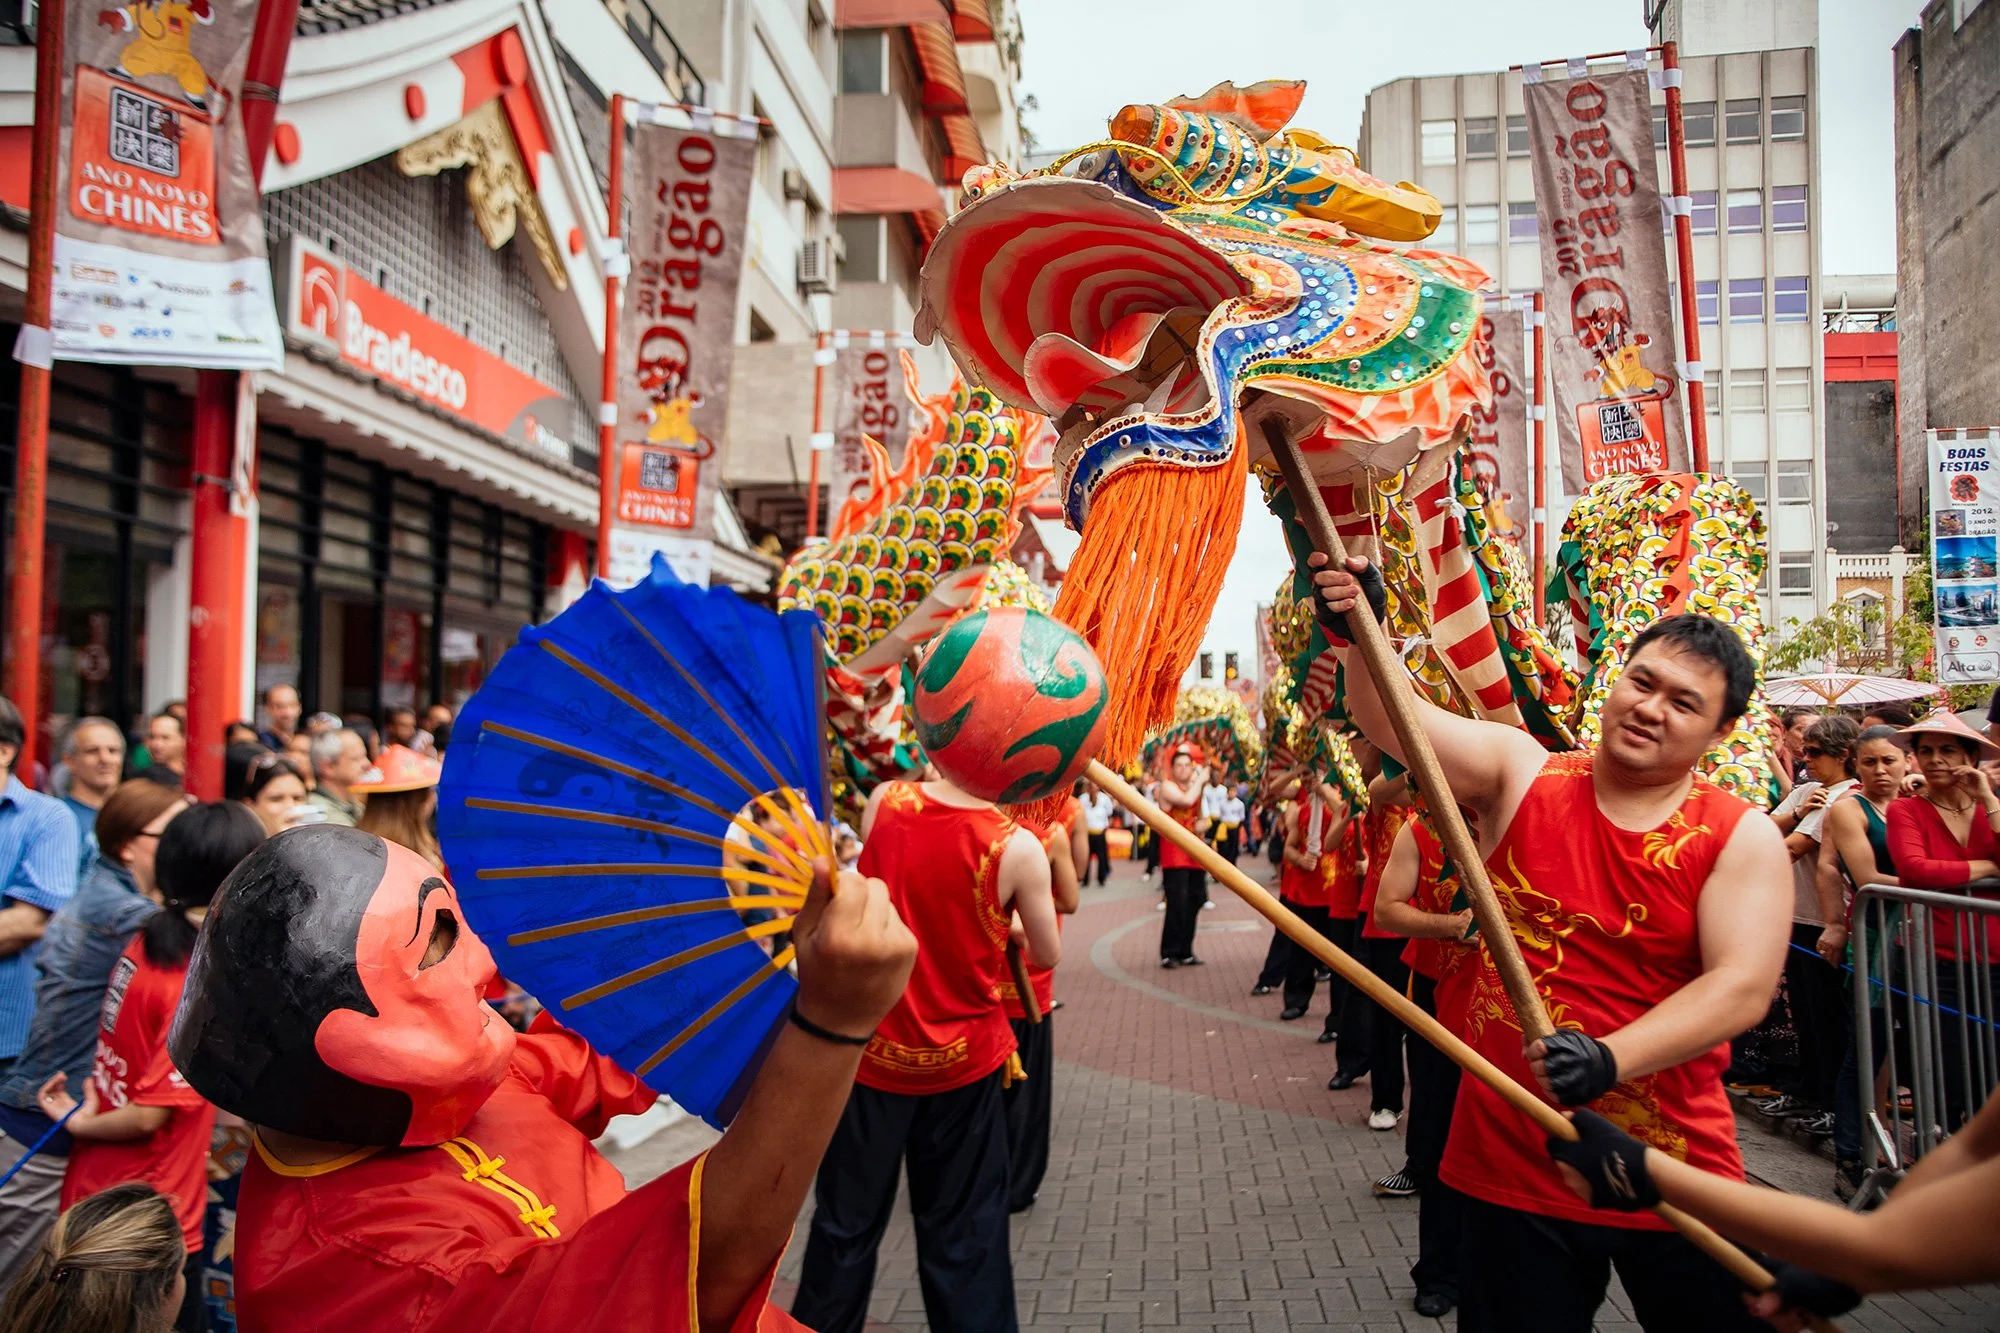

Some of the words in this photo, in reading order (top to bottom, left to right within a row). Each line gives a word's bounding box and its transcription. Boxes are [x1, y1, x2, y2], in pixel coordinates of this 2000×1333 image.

[80, 161, 133, 190] ANO
[138, 176, 209, 209] NOVO
[1554, 81, 1636, 337] Dragão
[637, 136, 724, 386] Dragão
[1553, 215, 1580, 278] 2012
[344, 298, 468, 411] Bradesco
[1588, 448, 1617, 461] ANO
[1621, 440, 1661, 457] NOVO
[1939, 460, 1990, 473] FESTAS
[1947, 447, 1986, 459] BOAS
[1971, 507, 1993, 515] 2012
[1947, 660, 1976, 673] Alta
